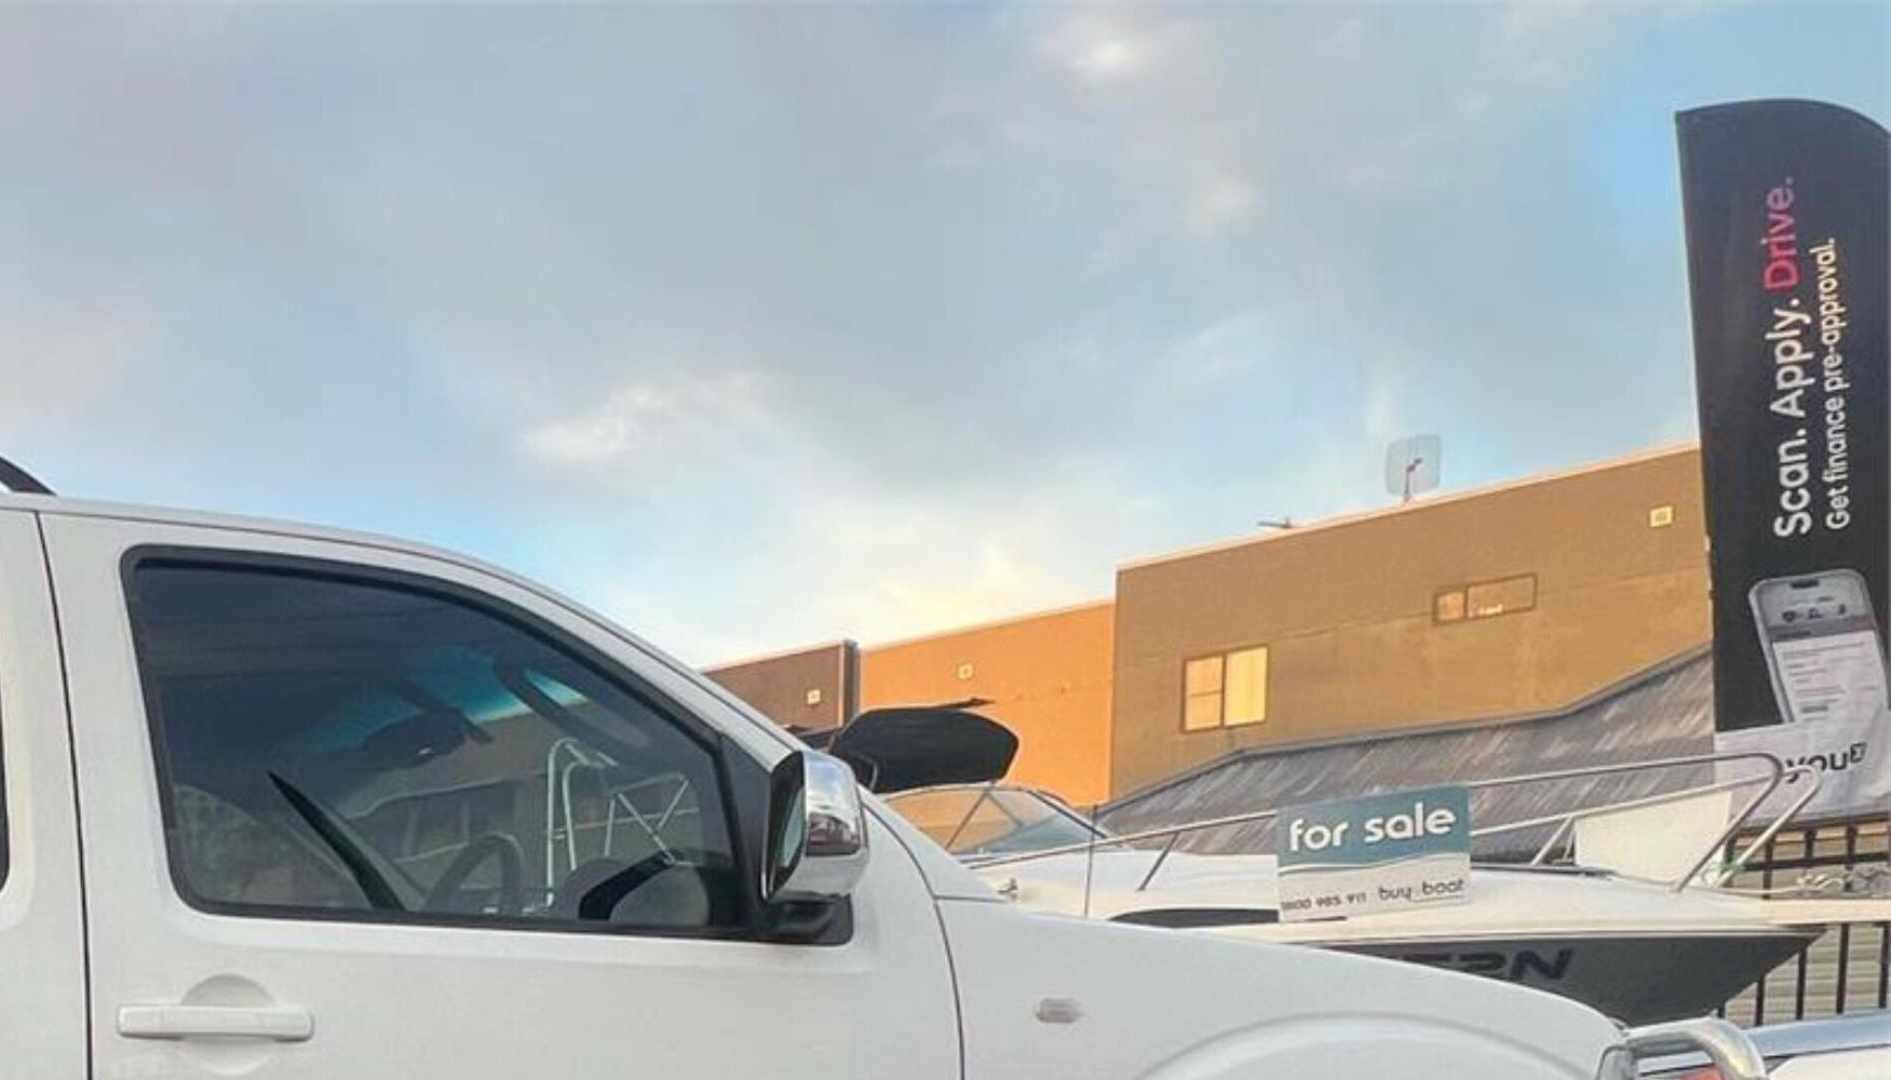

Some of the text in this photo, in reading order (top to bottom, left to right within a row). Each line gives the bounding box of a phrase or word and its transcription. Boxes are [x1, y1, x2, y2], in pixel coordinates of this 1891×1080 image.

[1761, 176, 1816, 537] Scan. Apply. Drive.
[1809, 237, 1851, 530] Get finance pre-approval.
[1289, 802, 1456, 851] for sale
